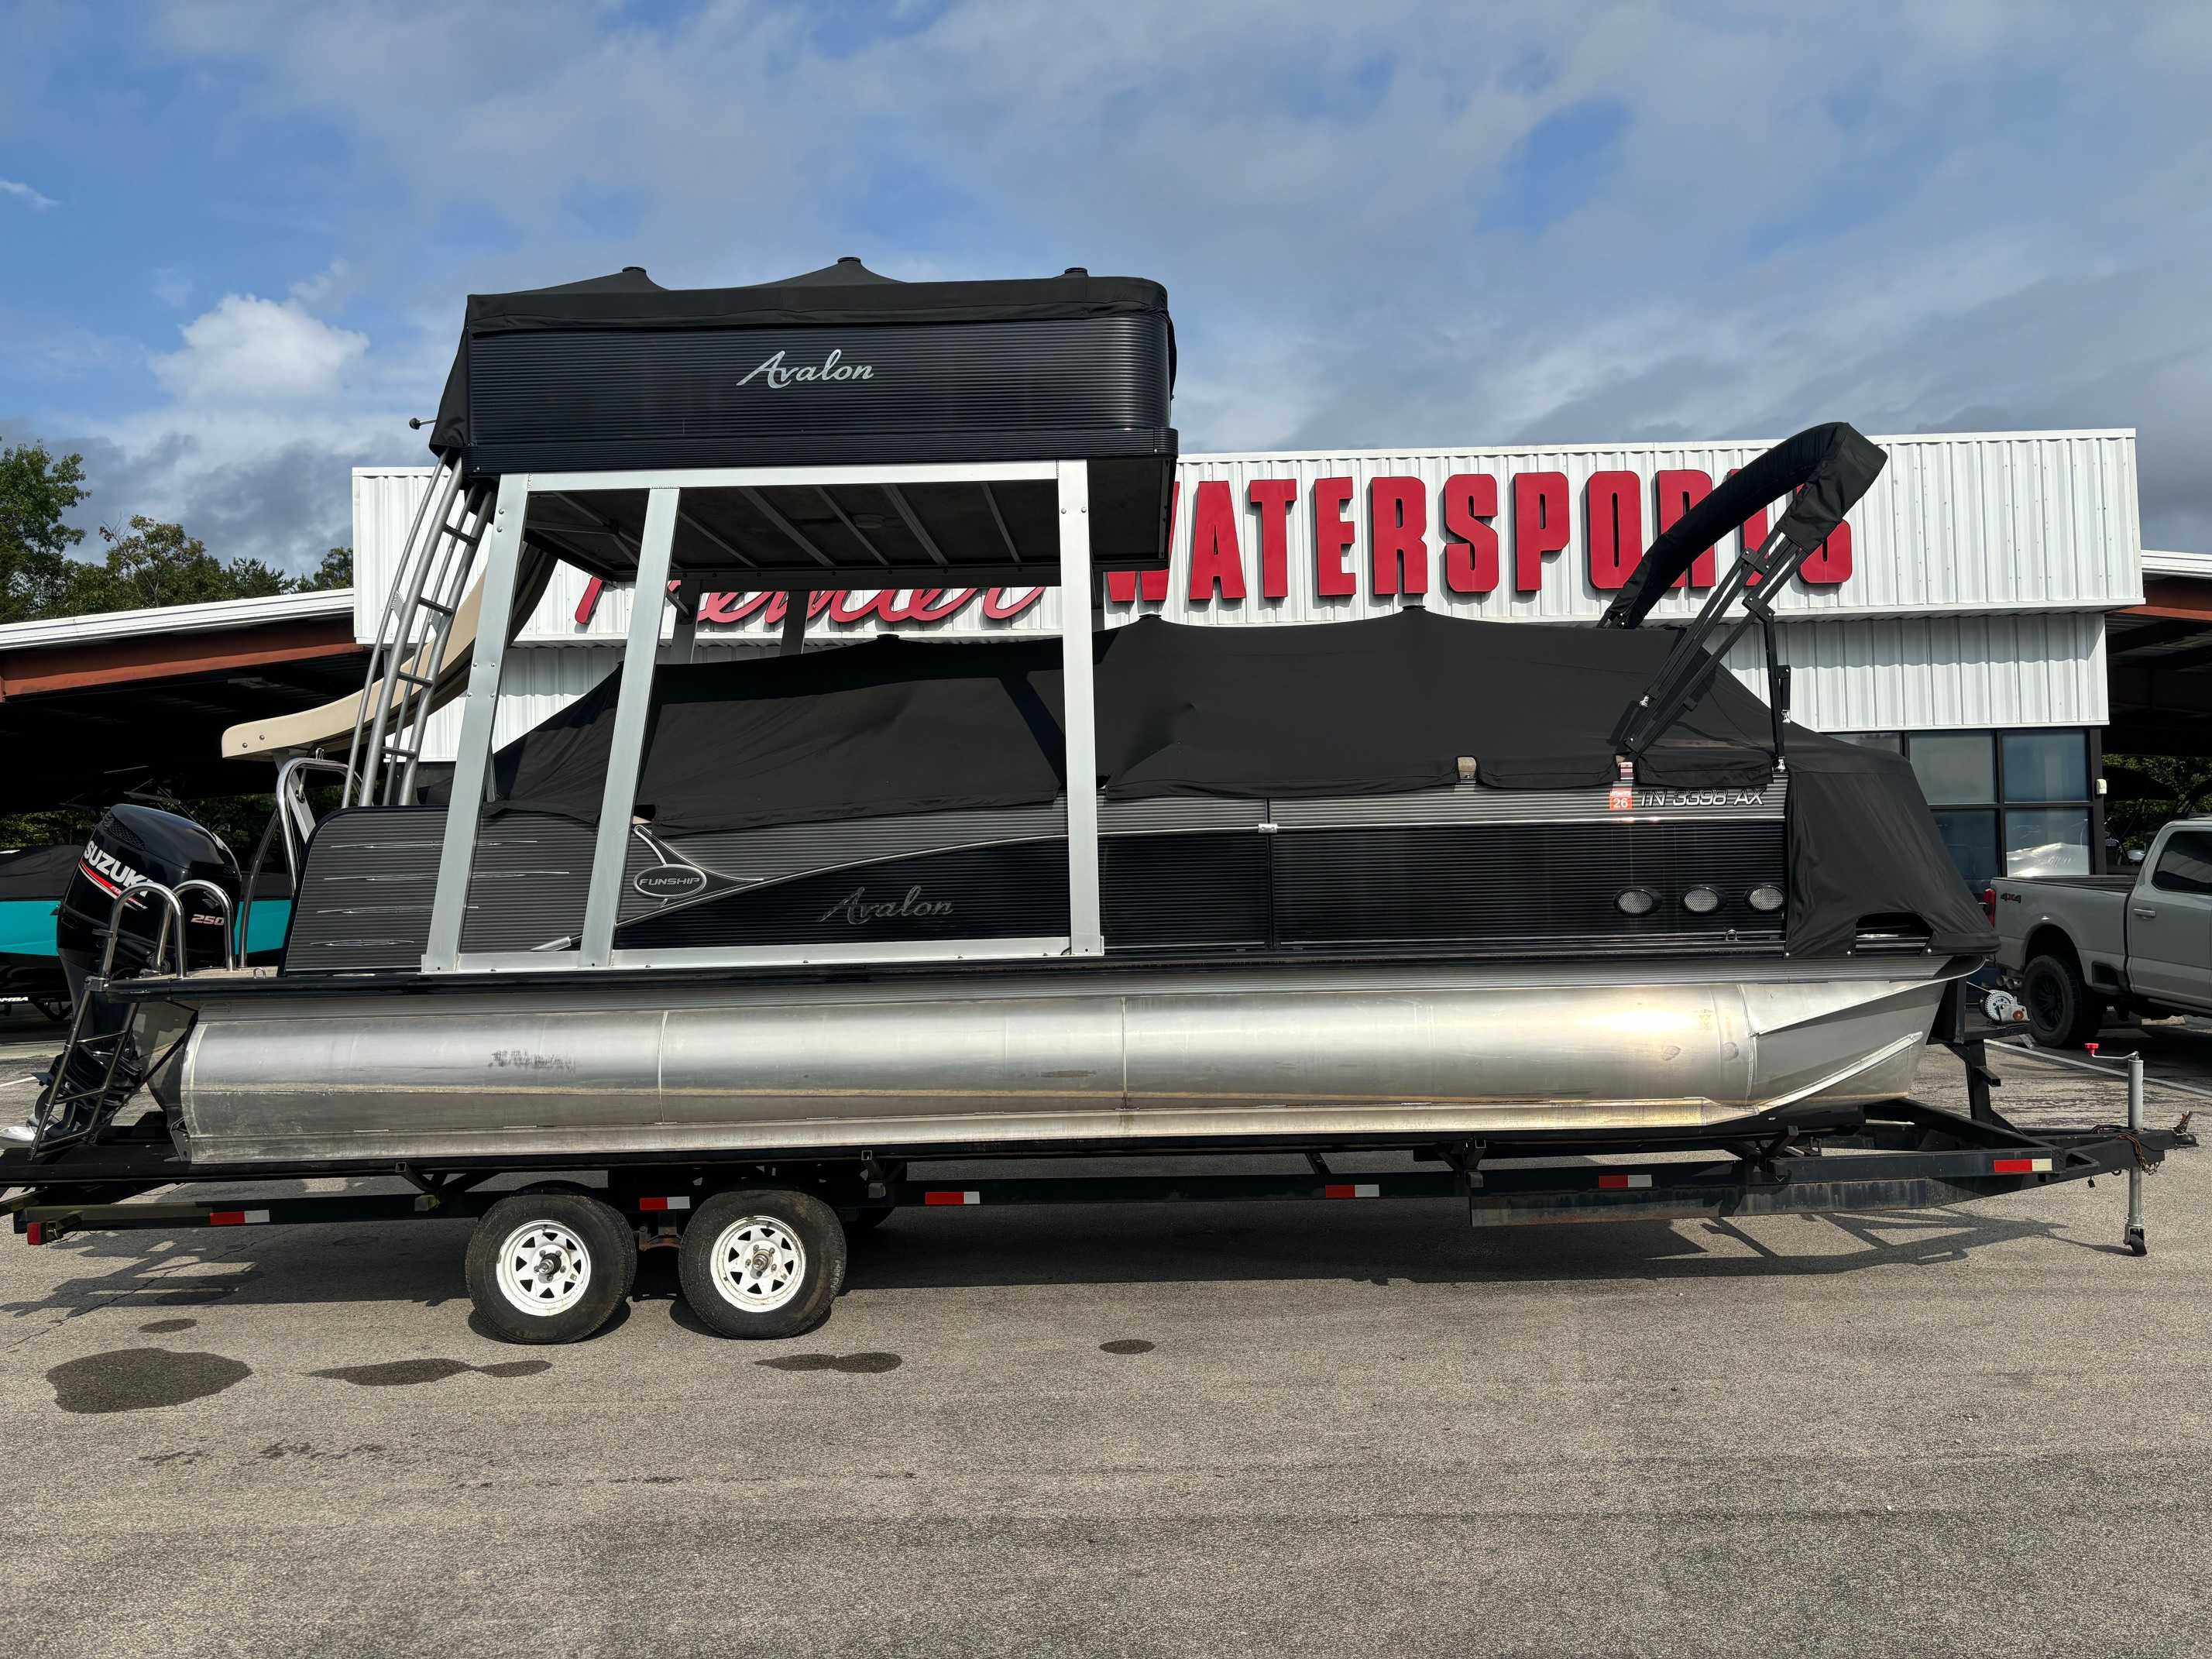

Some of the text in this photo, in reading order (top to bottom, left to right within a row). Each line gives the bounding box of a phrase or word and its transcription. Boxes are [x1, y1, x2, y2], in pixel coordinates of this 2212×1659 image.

[737, 349, 874, 388] Avalon
[1613, 798, 1629, 808] 26
[1638, 789, 1666, 806] TN
[1733, 788, 1767, 805] AX
[818, 885, 953, 925] Avalon
[191, 914, 225, 926] 250
